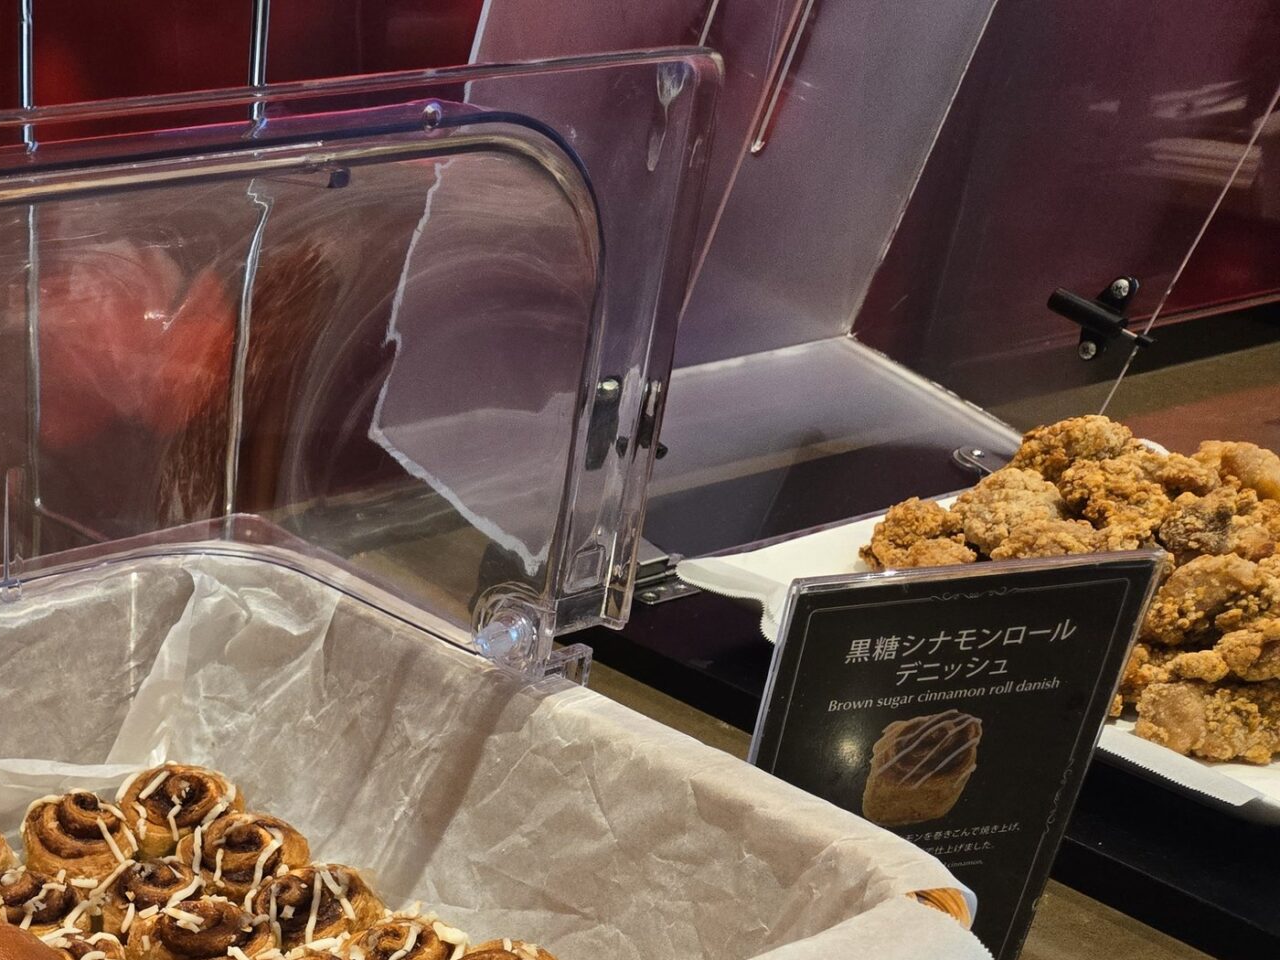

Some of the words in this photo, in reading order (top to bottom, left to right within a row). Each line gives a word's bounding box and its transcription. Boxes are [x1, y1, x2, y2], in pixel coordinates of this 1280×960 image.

[844, 619, 1077, 664] 黒糖シナモンロール
[895, 656, 1009, 686] デニッシュ
[827, 699, 873, 712] Brown
[876, 695, 915, 709] sugar
[917, 687, 986, 703] cinnamon
[989, 681, 1014, 695] roll
[1016, 676, 1061, 692] danish
